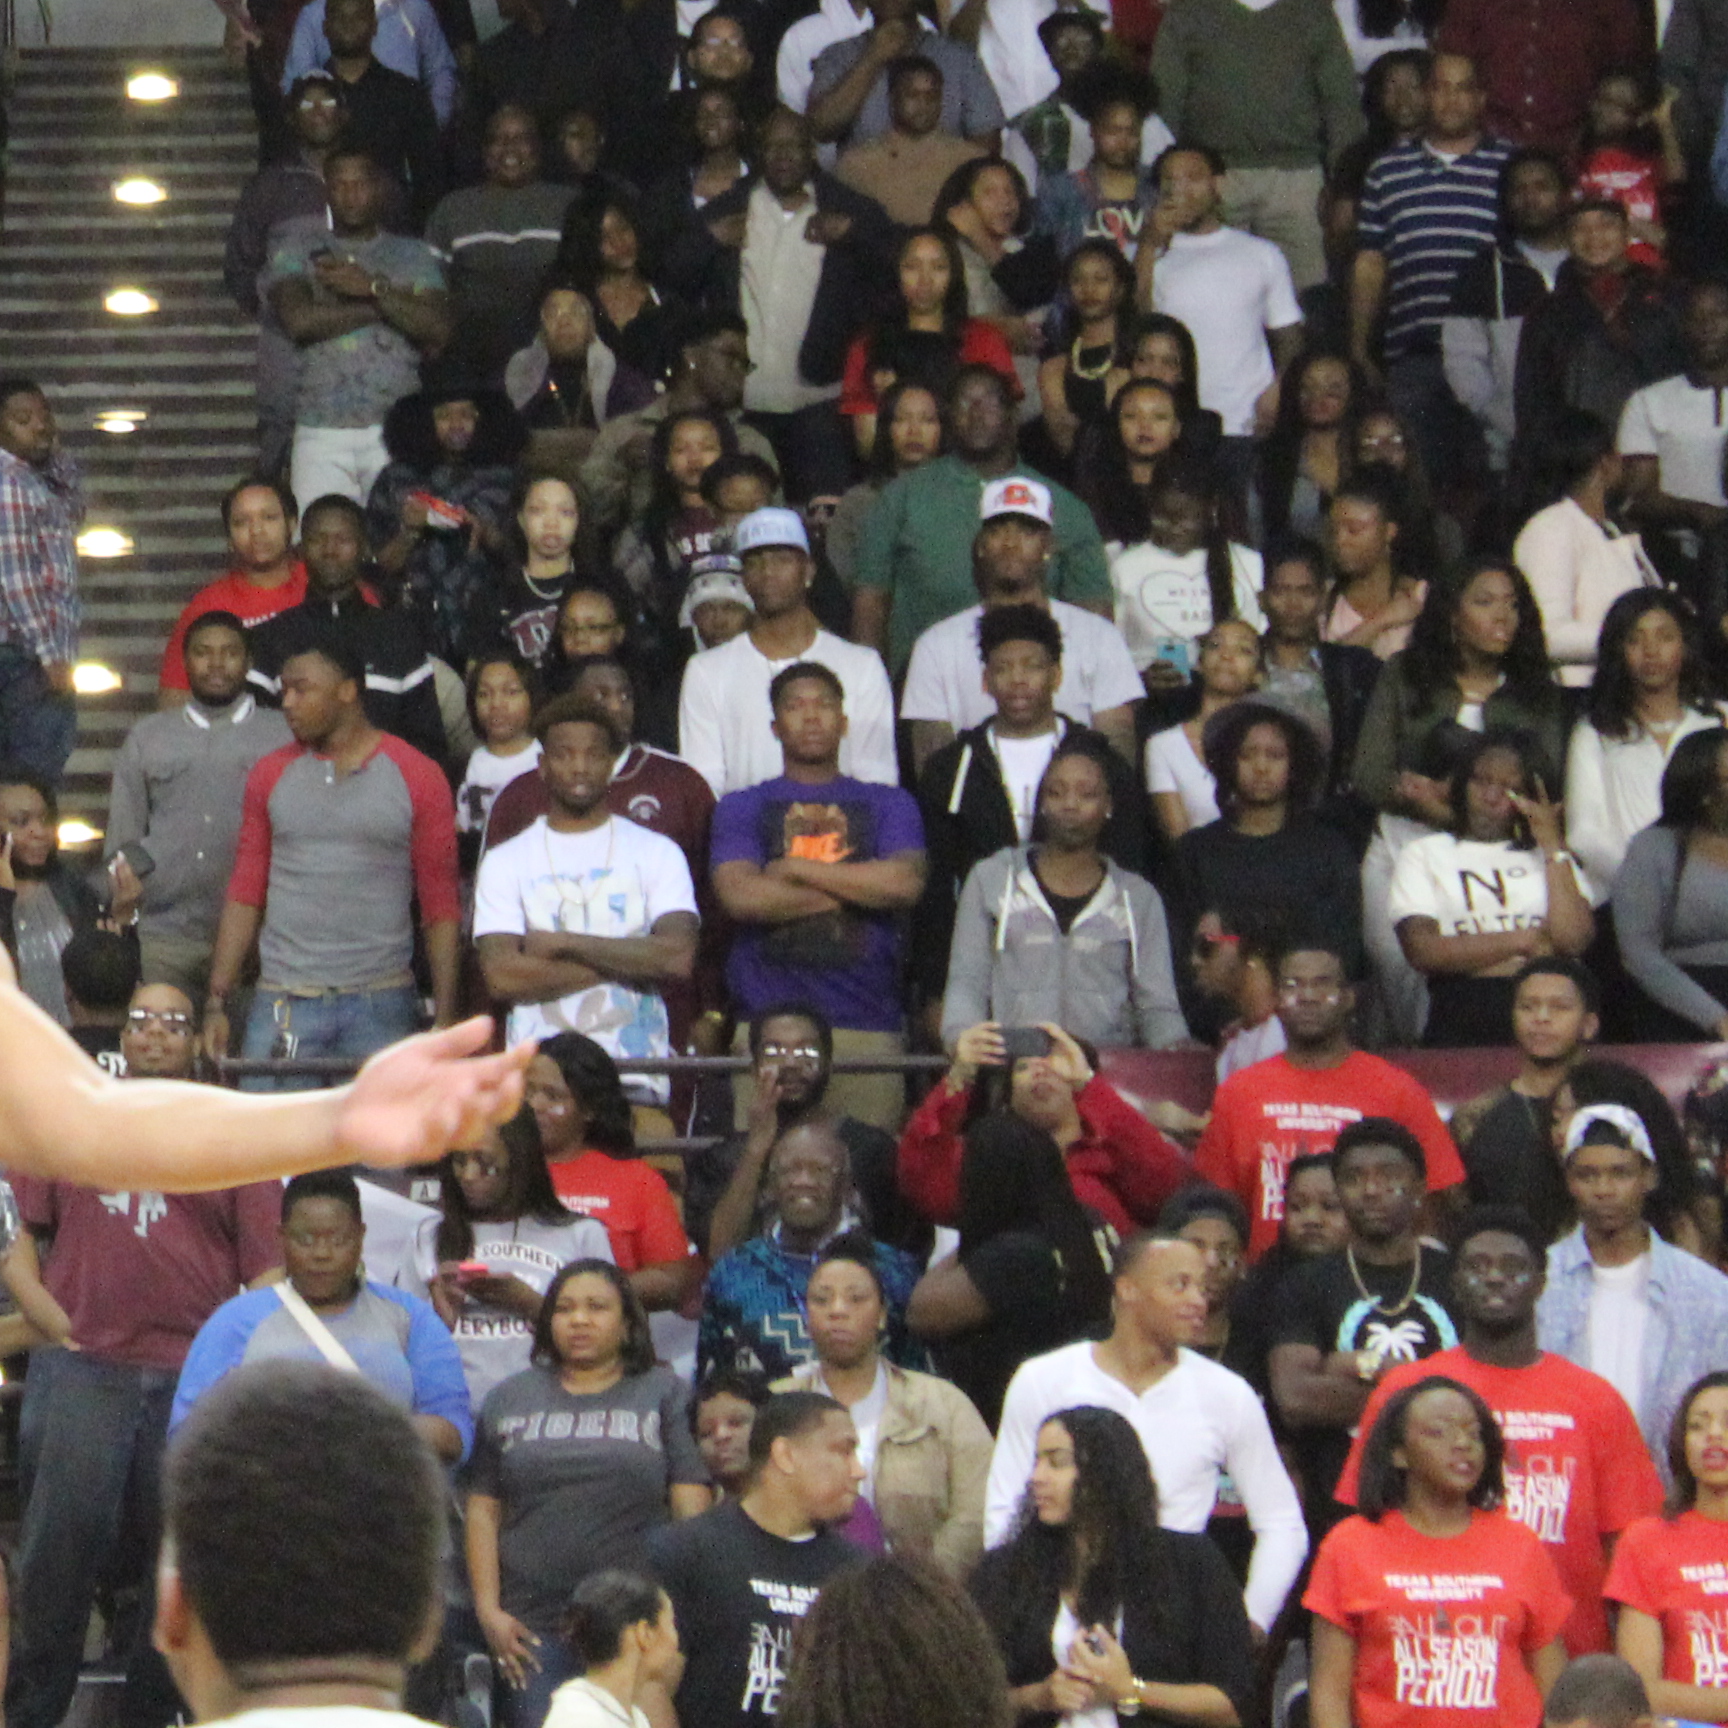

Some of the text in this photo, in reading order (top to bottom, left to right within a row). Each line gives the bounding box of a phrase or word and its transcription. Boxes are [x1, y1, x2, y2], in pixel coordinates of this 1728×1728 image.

[747, 1578, 790, 1599] TEXAS
[1384, 1574, 1504, 1590] TEXAS SOUTHERN
[1405, 1588, 1485, 1602] UNIVERSITY
[1392, 1634, 1499, 1671] ALL SEASON
